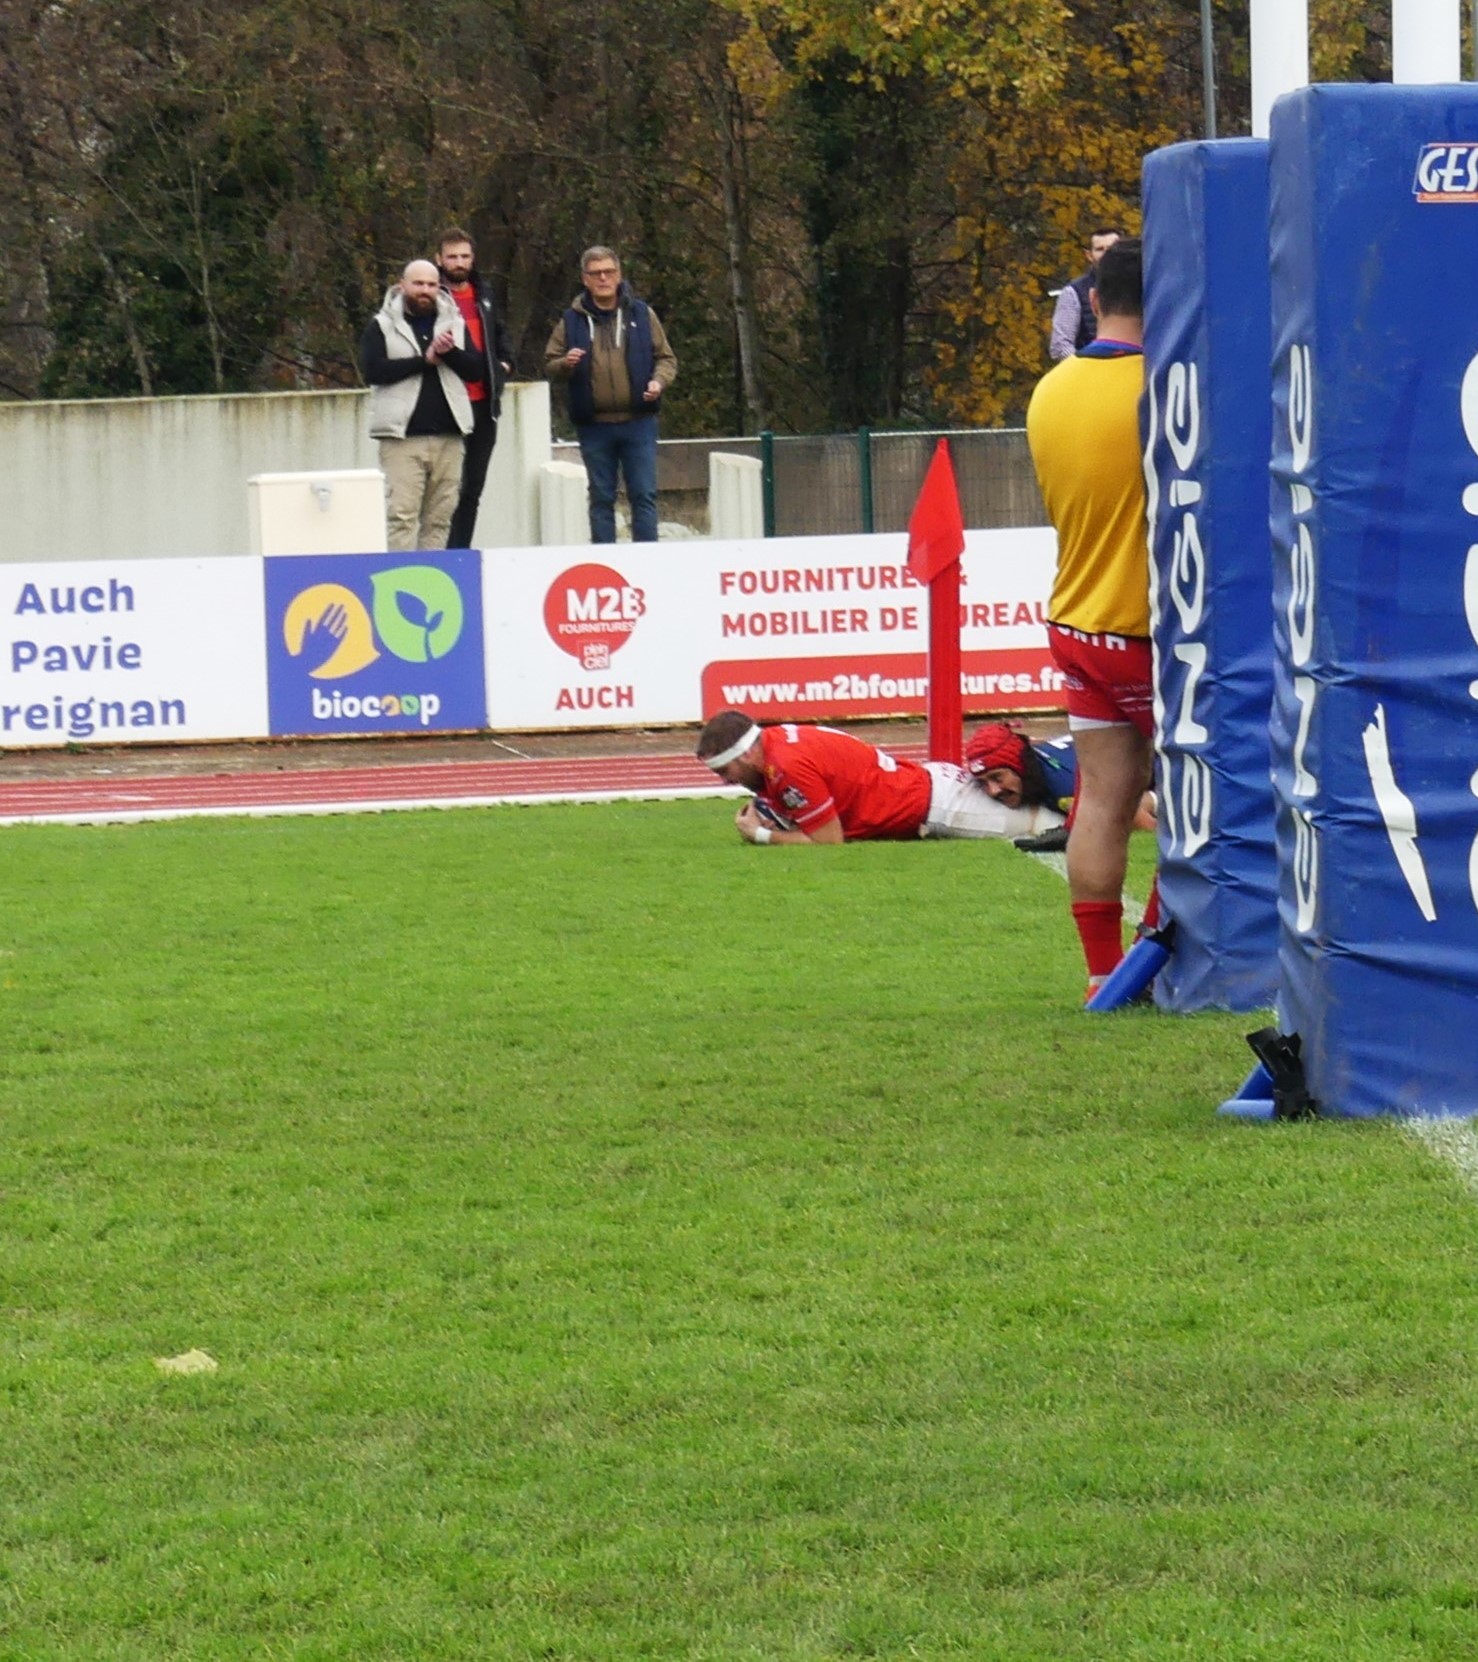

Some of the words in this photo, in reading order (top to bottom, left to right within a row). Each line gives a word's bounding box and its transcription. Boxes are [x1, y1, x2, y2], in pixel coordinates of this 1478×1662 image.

[14, 578, 135, 615] Auch
[719, 564, 928, 596] FOURNITURE
[565, 585, 646, 622] M2B
[722, 607, 869, 638] MOBILIER
[879, 605, 918, 632] DE
[958, 601, 1048, 629] UREAU
[557, 620, 636, 635] FOURNITURES
[12, 636, 142, 673] Pavie
[555, 685, 633, 711] AUCH
[722, 665, 1066, 705] www.m2bfourtures.fr
[2, 696, 186, 738] reignan
[312, 689, 440, 725] biocoop
